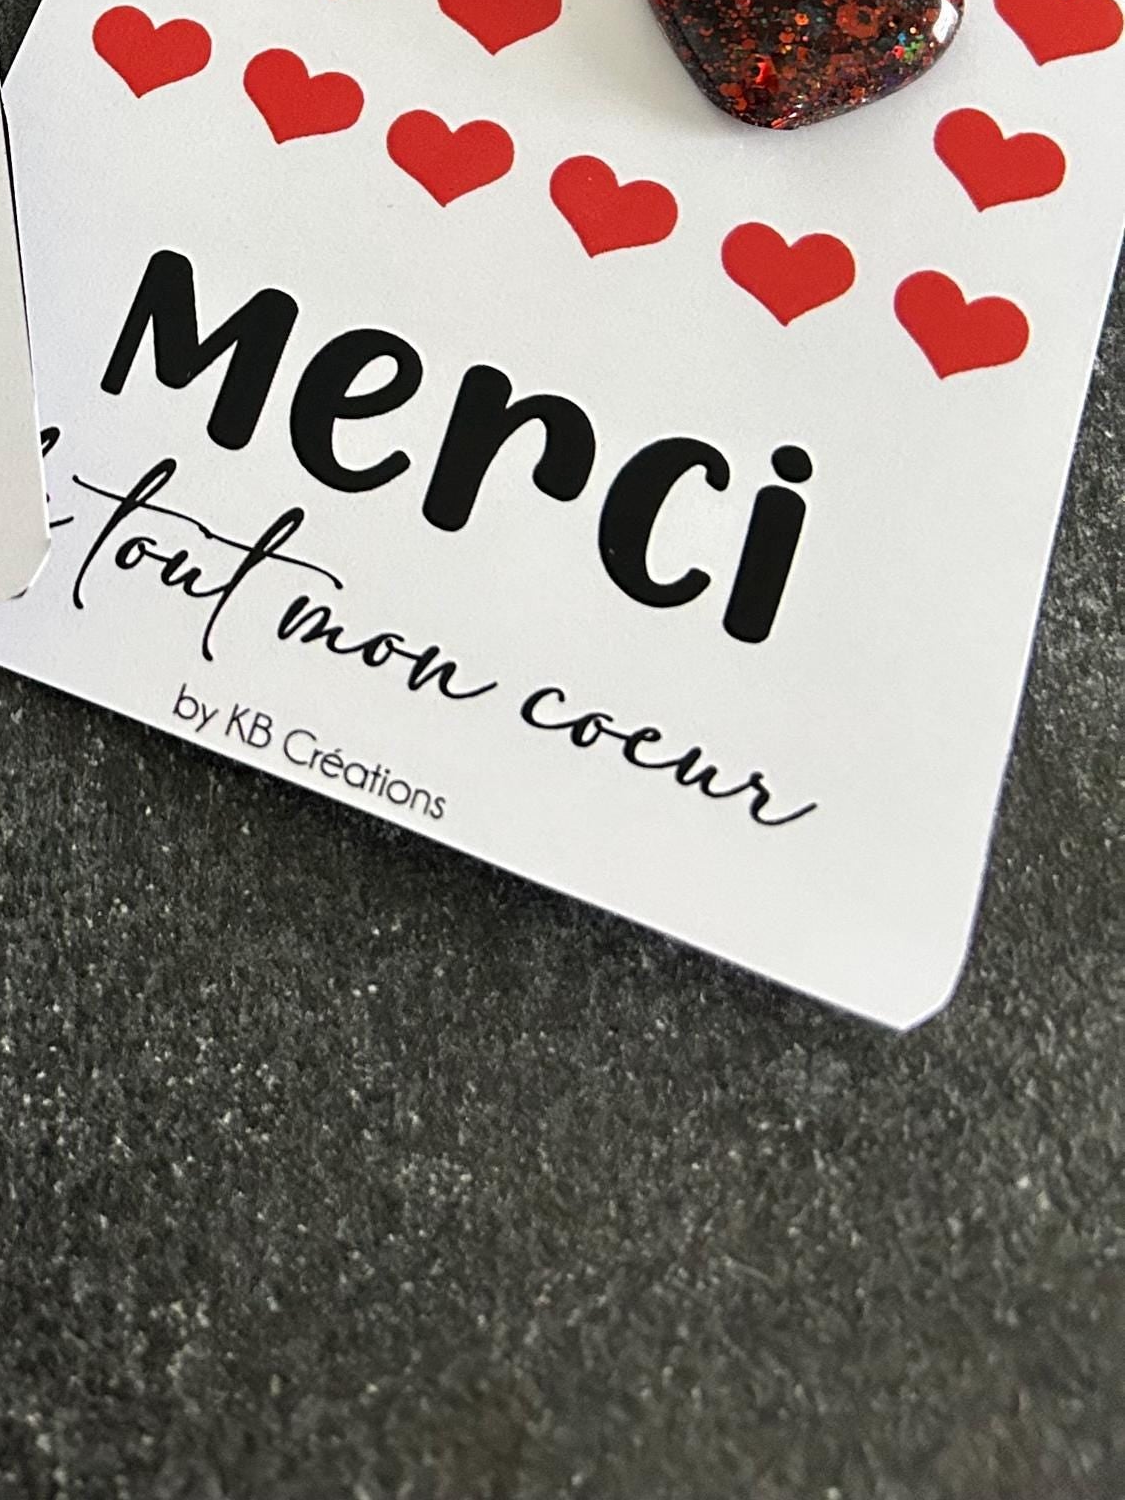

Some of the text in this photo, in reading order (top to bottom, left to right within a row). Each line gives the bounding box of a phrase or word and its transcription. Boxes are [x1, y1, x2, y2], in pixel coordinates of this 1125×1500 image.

[99, 248, 814, 645] Merci
[71, 457, 345, 663] tout
[276, 594, 499, 701] mon
[519, 686, 818, 827] coeur
[171, 682, 447, 821] by KB Créations
